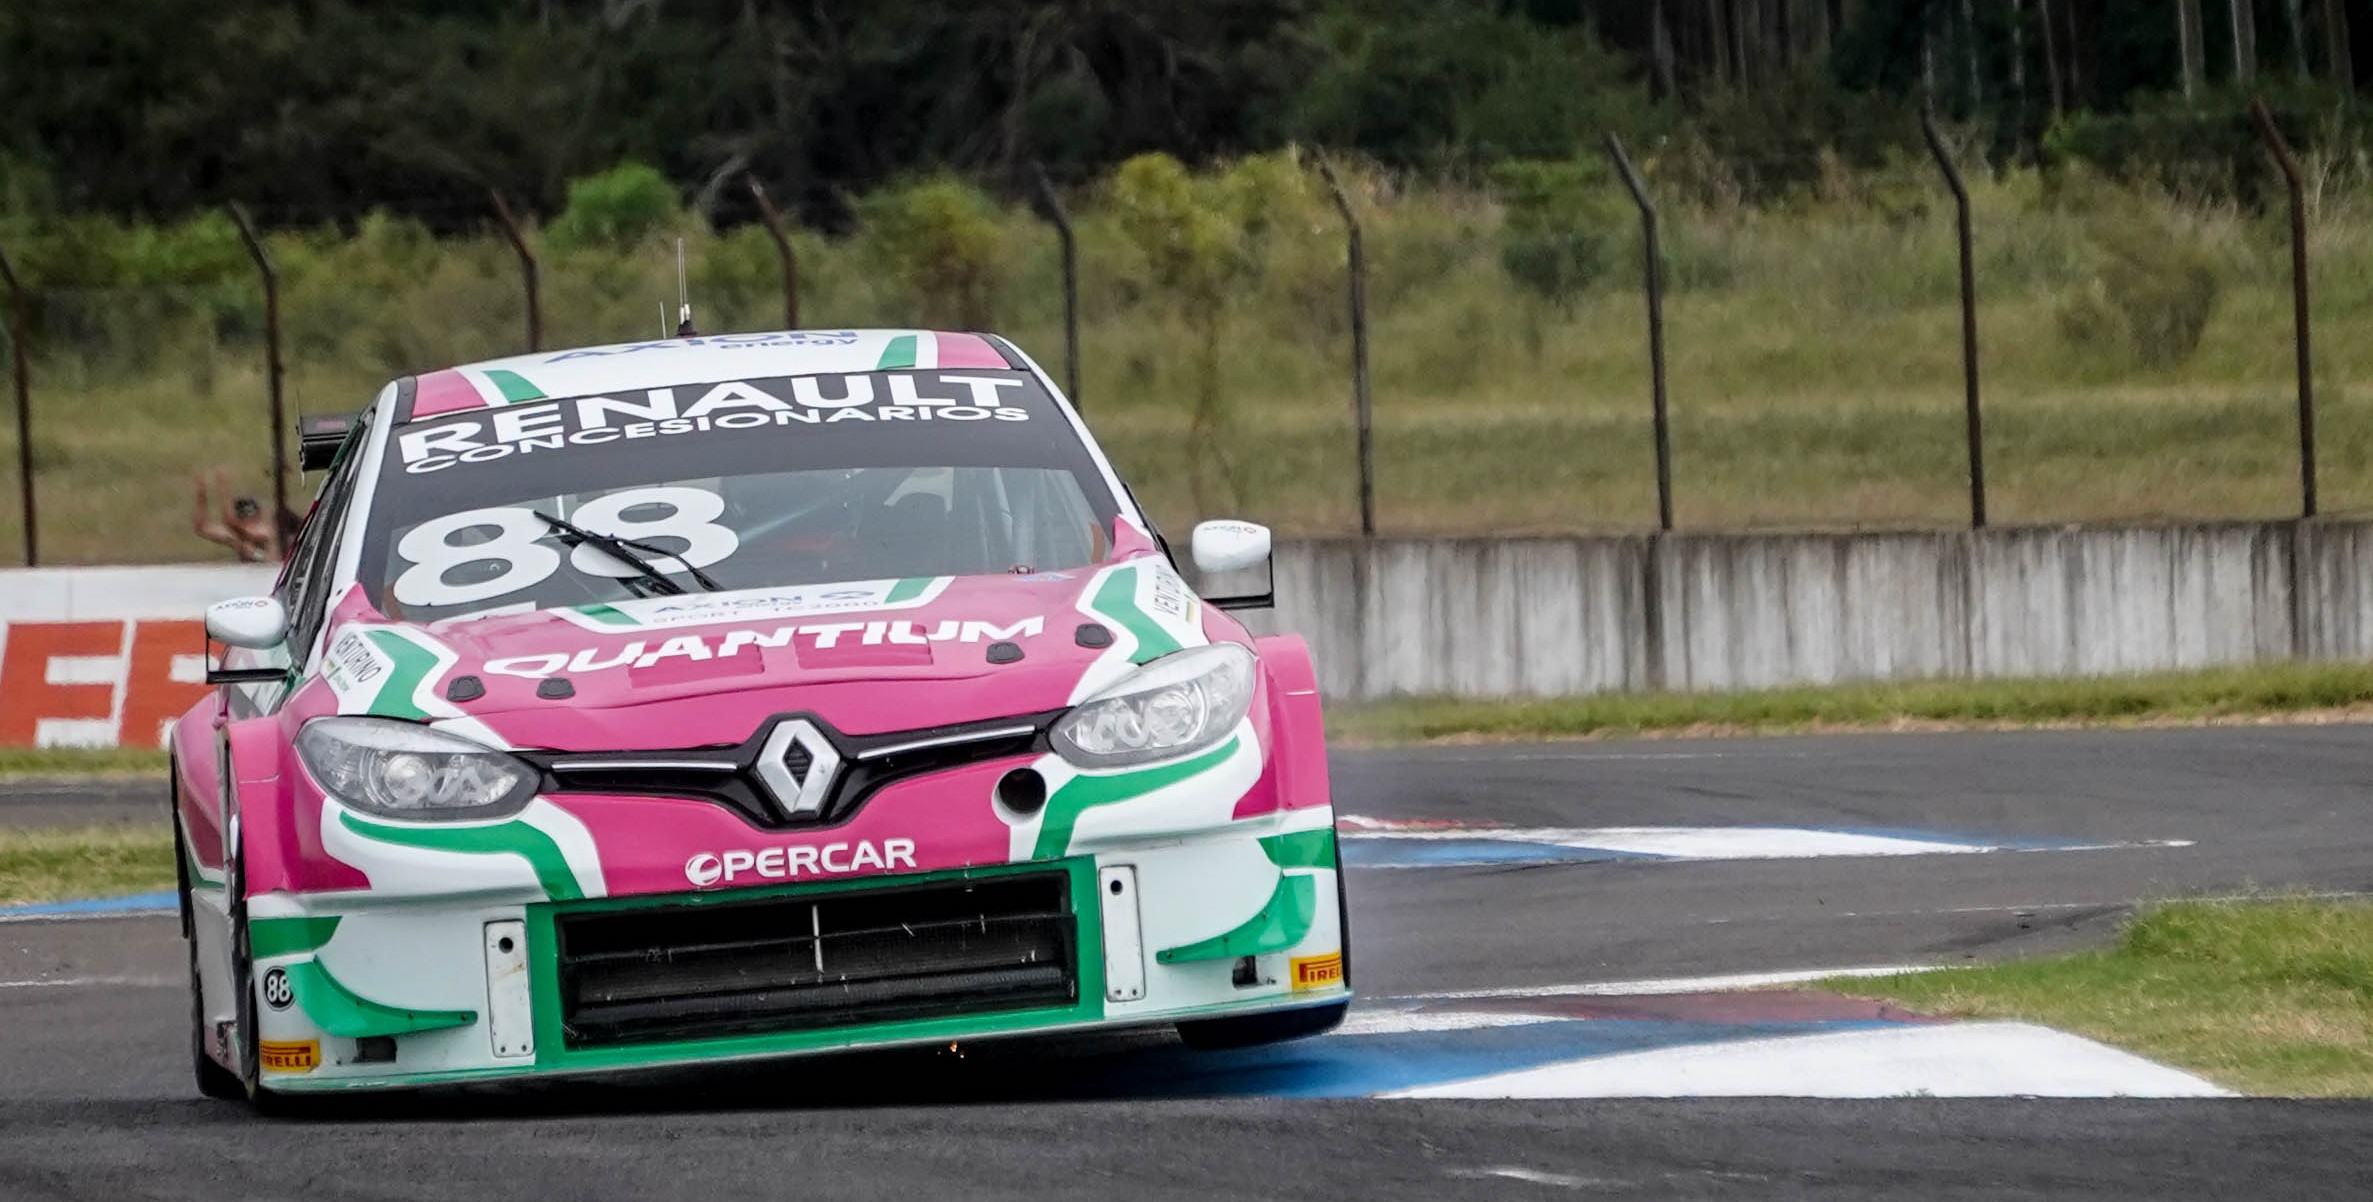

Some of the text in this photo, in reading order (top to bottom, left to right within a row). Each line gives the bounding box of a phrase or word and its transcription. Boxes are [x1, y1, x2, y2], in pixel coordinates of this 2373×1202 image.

[720, 337, 858, 350] energy
[399, 374, 1024, 464] RENAULT
[405, 405, 1030, 474] CONCESIONARIOS
[393, 486, 740, 607] 88
[482, 615, 1046, 679] QUANTIUM
[267, 975, 291, 1002] 88
